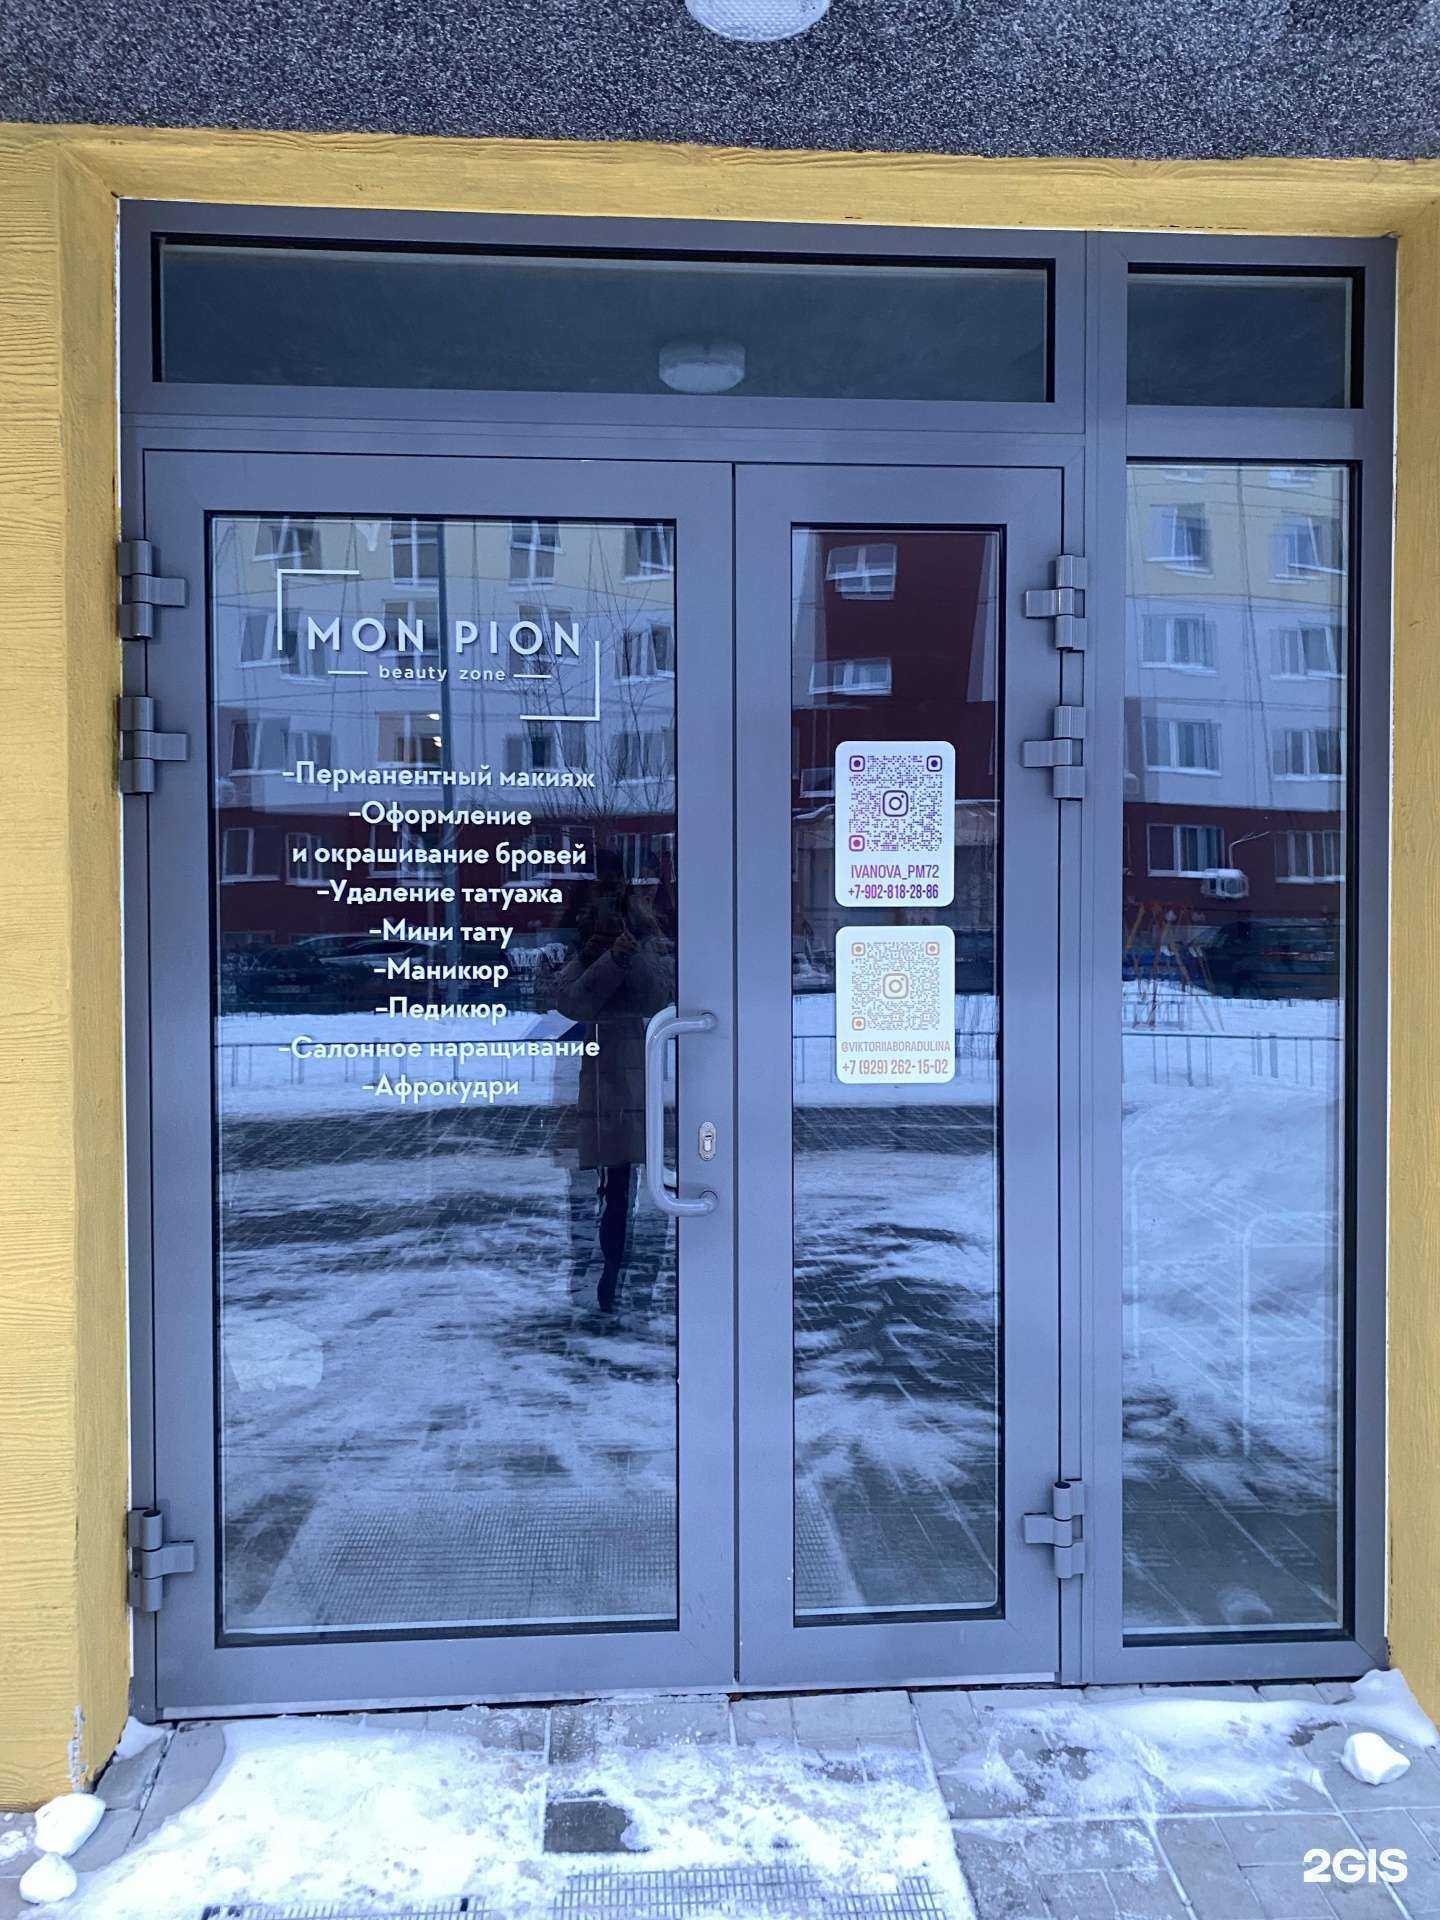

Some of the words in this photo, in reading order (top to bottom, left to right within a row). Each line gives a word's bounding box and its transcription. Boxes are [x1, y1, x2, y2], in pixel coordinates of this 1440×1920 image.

[307, 616, 425, 653] MON
[455, 620, 580, 657] PION
[379, 664, 448, 682] beauty
[459, 668, 506, 681] zone
[282, 760, 492, 792] -Перманентный
[500, 772, 596, 788] макияж
[349, 800, 532, 832] -Оформление
[292, 849, 307, 863] и
[314, 848, 490, 870] окрашивание
[495, 841, 587, 872] бровей
[851, 864, 940, 880] IVANOVA_PM72
[317, 879, 456, 905] -Удаление
[461, 887, 563, 910] татуажа
[848, 884, 939, 899] +7-902-818-28-86
[369, 919, 454, 941] -Мини
[460, 926, 514, 949] тату
[373, 957, 510, 987] -Маникюр
[375, 996, 508, 1025] -Педикюр
[278, 1036, 423, 1059] -Салонное
[430, 1041, 601, 1064] наращивание
[842, 1060, 856, 1075] +7
[859, 1059, 888, 1075] (929)
[891, 1059, 948, 1074] 262-15-02
[361, 1073, 520, 1104] -Афрокудри
